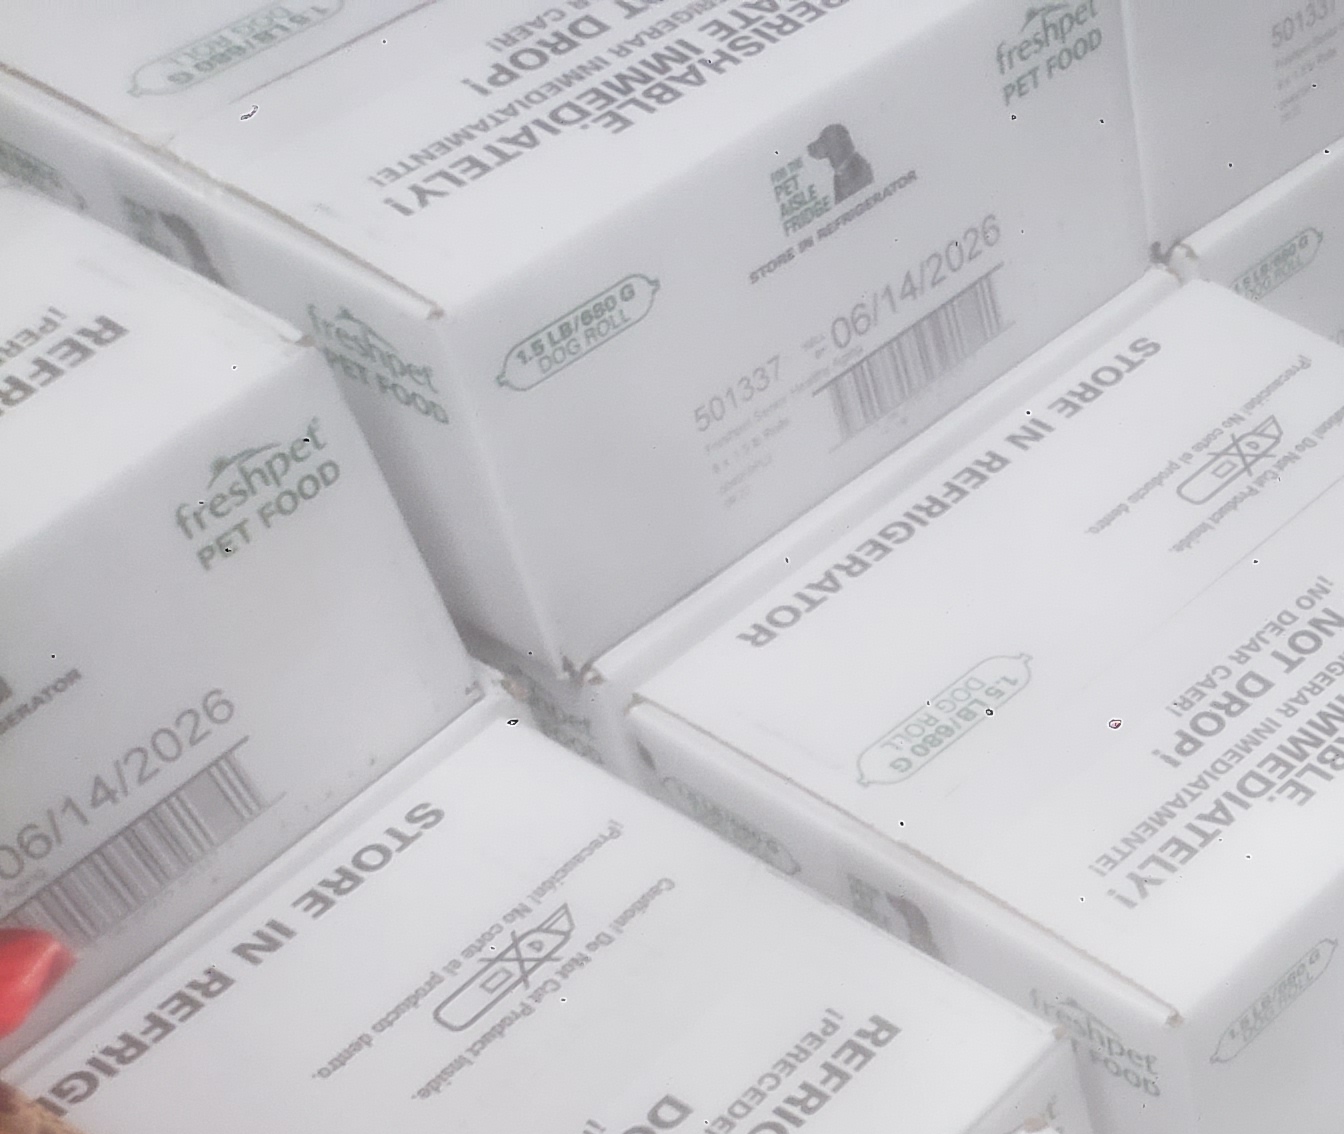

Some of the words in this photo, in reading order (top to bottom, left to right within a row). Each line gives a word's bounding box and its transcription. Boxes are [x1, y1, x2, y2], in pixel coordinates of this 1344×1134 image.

[460, 13, 612, 97] DROP!
[485, 7, 568, 52] CAER!
[995, 2, 1100, 76] freshpet
[1002, 65, 1042, 106] PET
[1045, 28, 1103, 80] FOOD
[367, 55, 613, 187] INMEDIATAMENTE!
[382, 37, 705, 217] IMMEDIATELY!
[774, 174, 801, 201] PET
[782, 195, 832, 237] FRIDGE
[748, 246, 796, 285] STORE
[816, 169, 918, 242] REFRIGERATOR
[830, 213, 1001, 350] 06/14/2026
[515, 337, 545, 365] 1.5
[546, 294, 618, 349] LB/680
[538, 337, 581, 374] DOG
[584, 308, 632, 347] ROLL
[693, 353, 782, 433] 501337
[1047, 336, 1162, 420] STORE
[1004, 417, 1055, 452] IN
[174, 415, 328, 541] freshpet
[195, 517, 252, 572] PET
[256, 459, 341, 529] FOOD
[735, 449, 1013, 649] REFRIGERATOR
[1227, 608, 1300, 667] DEJAR
[933, 675, 986, 714] DOG
[983, 673, 1020, 701] 1.5
[1150, 668, 1275, 769] DROP!
[1165, 664, 1232, 720] CAER!
[881, 710, 941, 753] ROLL
[909, 697, 991, 759] LB/680
[0, 687, 235, 880] 06/14/2026
[888, 755, 914, 775] G
[1088, 715, 1283, 879] INMEDIATAMENTE!
[291, 800, 446, 920] STORE
[502, 901, 533, 925] No
[609, 876, 677, 935] Caution!
[231, 917, 299, 967] IN
[461, 922, 505, 959] corte
[556, 950, 593, 982] Not
[371, 969, 446, 1035] producto
[463, 1000, 537, 1057] Product
